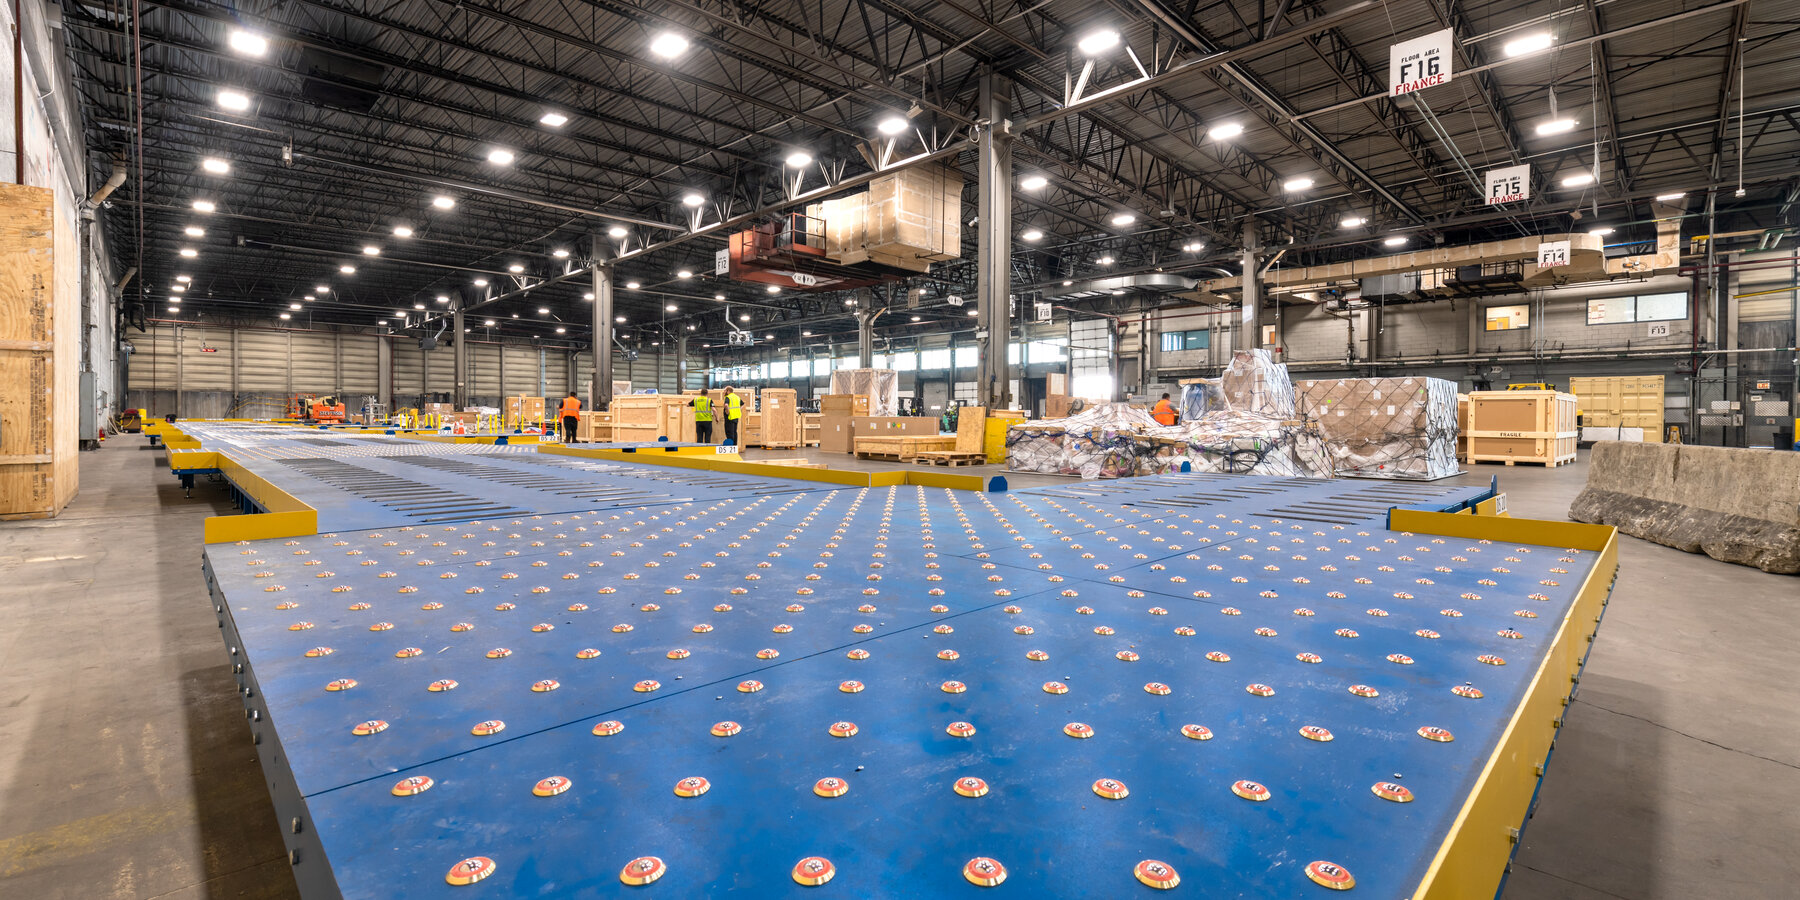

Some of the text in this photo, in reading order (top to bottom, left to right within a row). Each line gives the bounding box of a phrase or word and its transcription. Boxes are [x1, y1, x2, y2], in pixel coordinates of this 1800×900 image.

[1401, 48, 1440, 63] FLOOR AREA
[1400, 56, 1440, 84] F16
[1395, 73, 1445, 95] FRANCE
[1493, 181, 1520, 197] F15
[1490, 193, 1524, 205] FRANCE
[1543, 252, 1565, 263] F14
[717, 259, 727, 270] F12
[1540, 260, 1567, 268] FRANCE
[718, 446, 736, 454] DS 21
